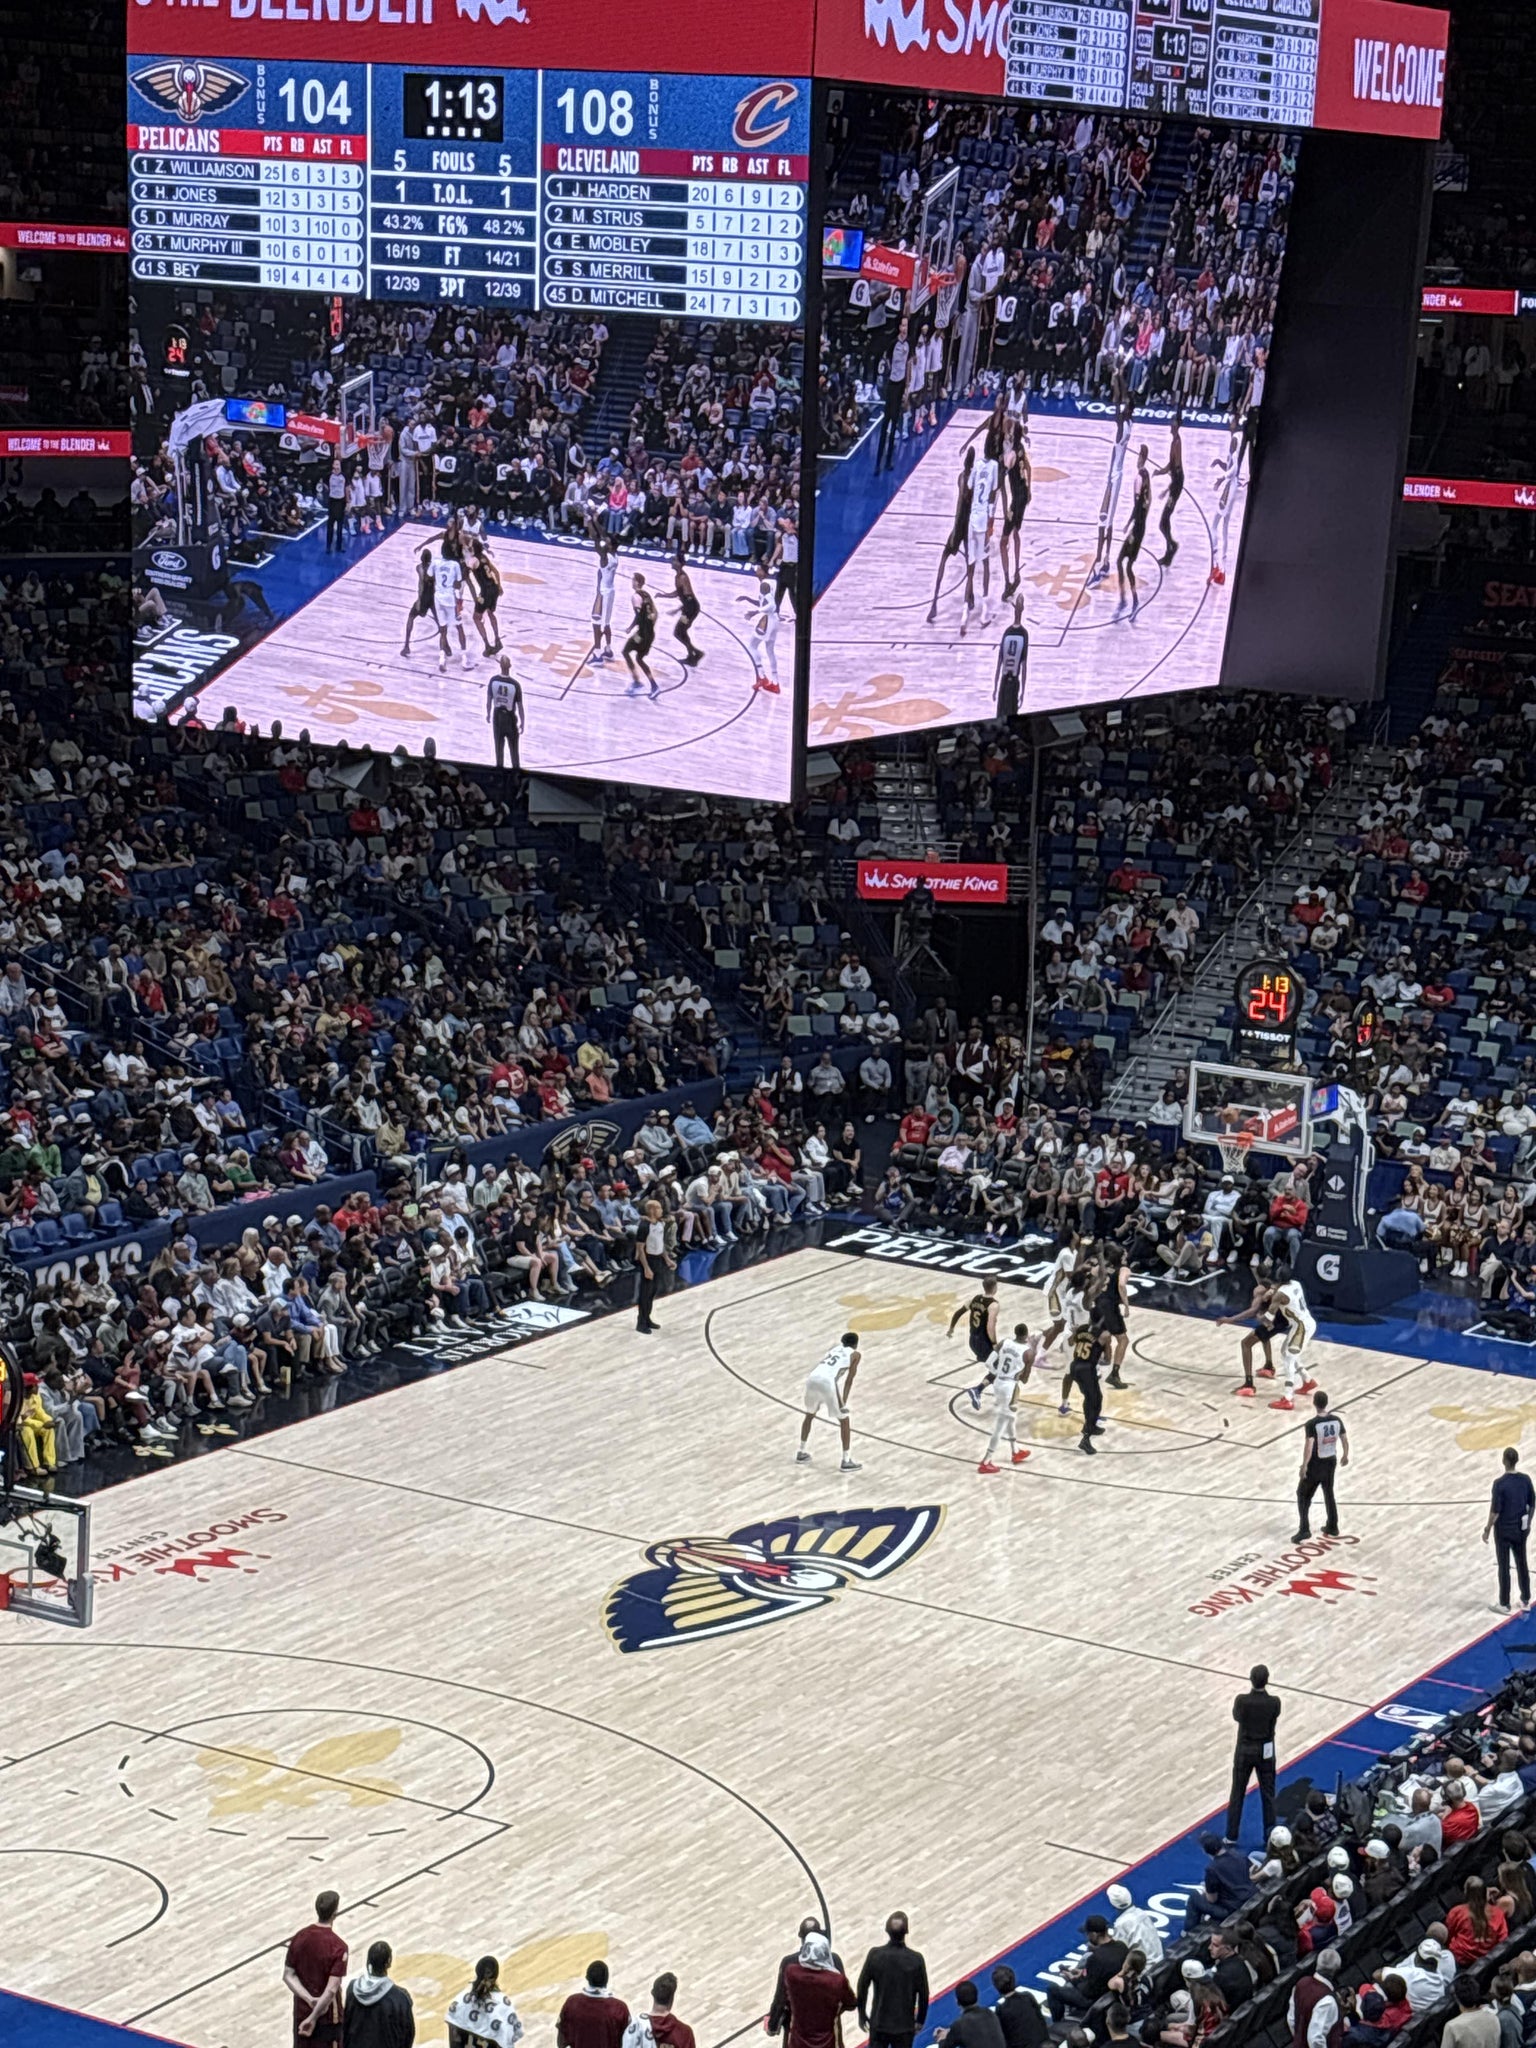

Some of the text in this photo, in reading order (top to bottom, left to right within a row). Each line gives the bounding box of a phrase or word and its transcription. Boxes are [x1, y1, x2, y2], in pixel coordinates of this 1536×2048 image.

[1162, 32, 1186, 56] 1:13
[1353, 37, 1444, 109] WELCOME
[256, 65, 265, 124] BONUS
[279, 78, 351, 124] 104
[425, 80, 497, 121] 1:13
[1132, 82, 1207, 102] FOULS FOULS
[556, 88, 633, 136] 108
[648, 79, 659, 140] BONUS
[139, 126, 220, 153] PELICANS
[264, 136, 352, 155] PTS RB AST FL
[142, 161, 350, 184] 1 Z. WILLIAMSON 25 6 3 3
[394, 150, 511, 176] 5 FOULS 5
[557, 148, 639, 175] CLEVELAND
[693, 155, 791, 176] PTS RB AST FL
[140, 186, 350, 209] 2 H. JONES 12 3 3 5
[396, 181, 510, 208] 1 T.O.L. 1
[557, 184, 789, 206] 1 J. HARDEN 20 6 9 2
[140, 212, 350, 236] 5 D. MURRAY 10 3 10 0
[383, 215, 525, 236] 43.2% FG% 48.2%
[555, 209, 788, 233] 2 M. STRUS 5 7 2 2
[18, 230, 56, 244] WELCOME
[77, 233, 111, 246] BLENDER
[137, 236, 349, 262] 25 T. MURPHY III 10 6 0 1
[554, 235, 788, 260] 4 E. MOBLEY 18 7 3 3
[385, 244, 520, 266] 16/19 FT 14/21
[139, 262, 350, 286] 41 S. BEY 19 4 4 4
[555, 263, 787, 289] 5 S. MERRILL 15 9 2 2
[385, 276, 521, 298] 12/39 3PT 12/39
[550, 288, 787, 316] 45 D. MITCHELL 24 7 3 1
[1422, 294, 1446, 306] NDER
[168, 348, 185, 363] 24
[8, 438, 41, 450] WELCOME
[61, 438, 95, 451] BLENDER
[1404, 483, 1441, 498] BLENDER
[556, 535, 676, 560] Ocsner
[158, 553, 180, 568] Ford
[1263, 974, 1289, 993] 1:13
[1249, 988, 1286, 1022] 24
[1255, 1031, 1291, 1043] TISSOT
[825, 1229, 1156, 1297] PELICAS
[1316, 1254, 1341, 1281] G
[972, 1311, 981, 1328] 5
[433, 1324, 547, 1361] MORRIS
[1076, 1342, 1090, 1359] 45
[1002, 1356, 1012, 1373] 5
[91, 1530, 168, 1558] CENTER
[126, 1508, 288, 1567] SMOOTHIE
[1187, 1532, 1360, 1618] SMOOTHIE KING
[1205, 1552, 1262, 1582] CENTER
